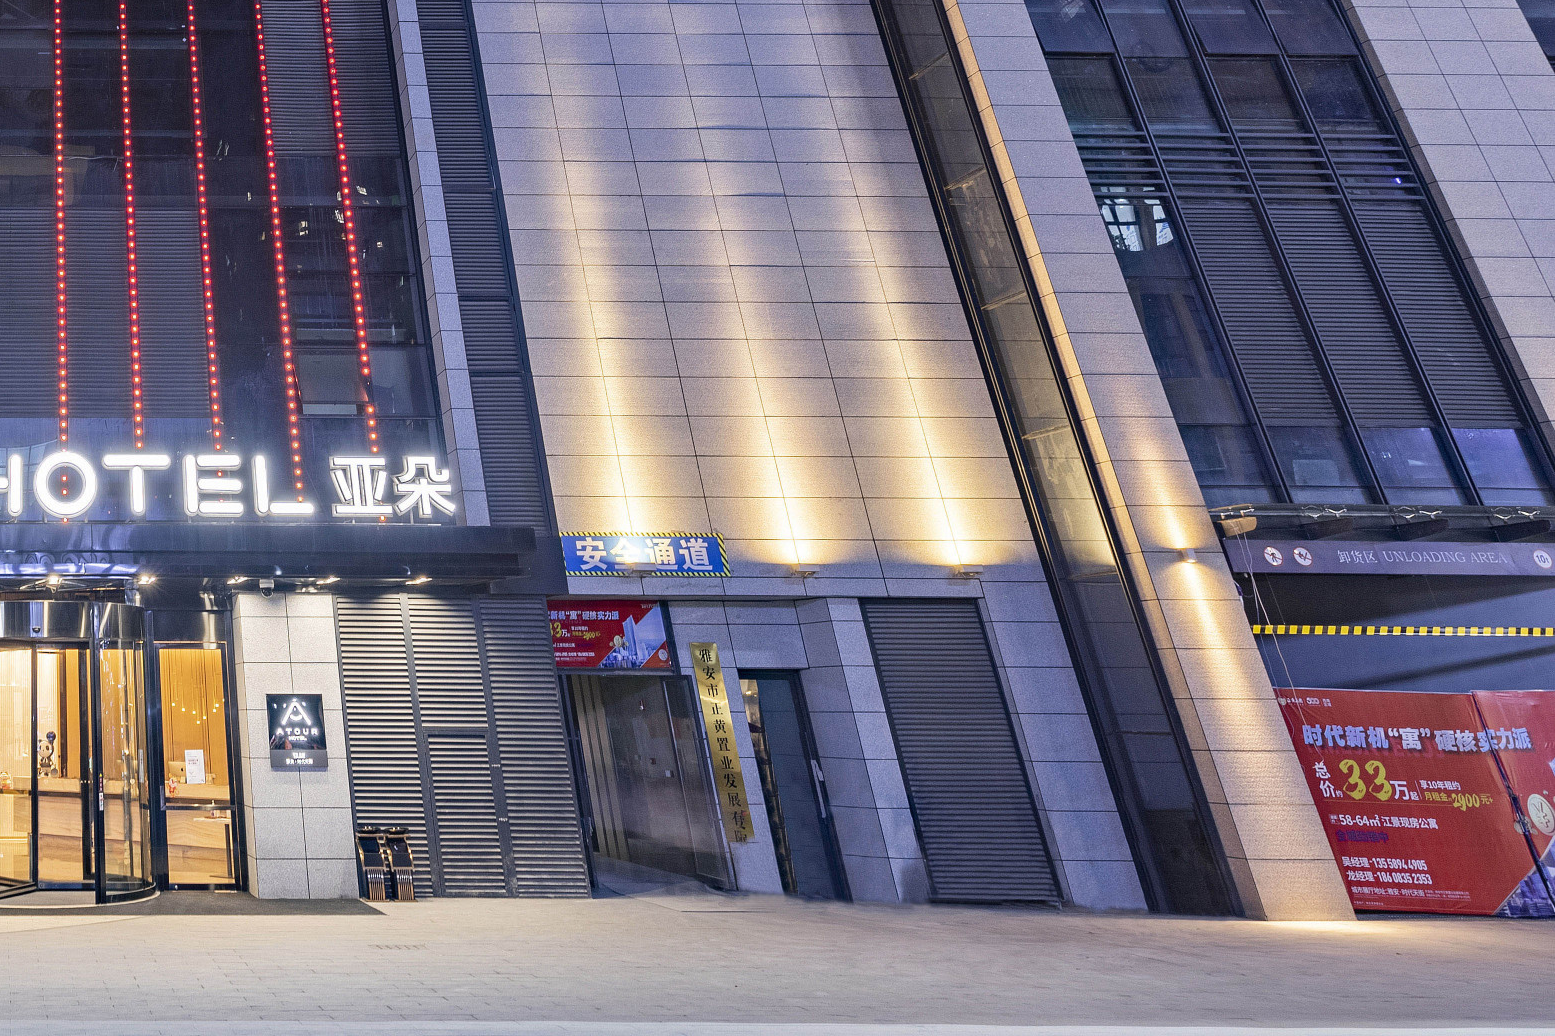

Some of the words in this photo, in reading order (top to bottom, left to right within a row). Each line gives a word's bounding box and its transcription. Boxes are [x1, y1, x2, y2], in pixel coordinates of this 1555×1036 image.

[329, 455, 456, 517] 亚朵
[575, 538, 714, 572] 安全通道
[1337, 549, 1377, 564] 卸货区
[1382, 550, 1466, 564] UNLOADING
[1470, 551, 1508, 564] AREA
[276, 727, 318, 736] ATOUR
